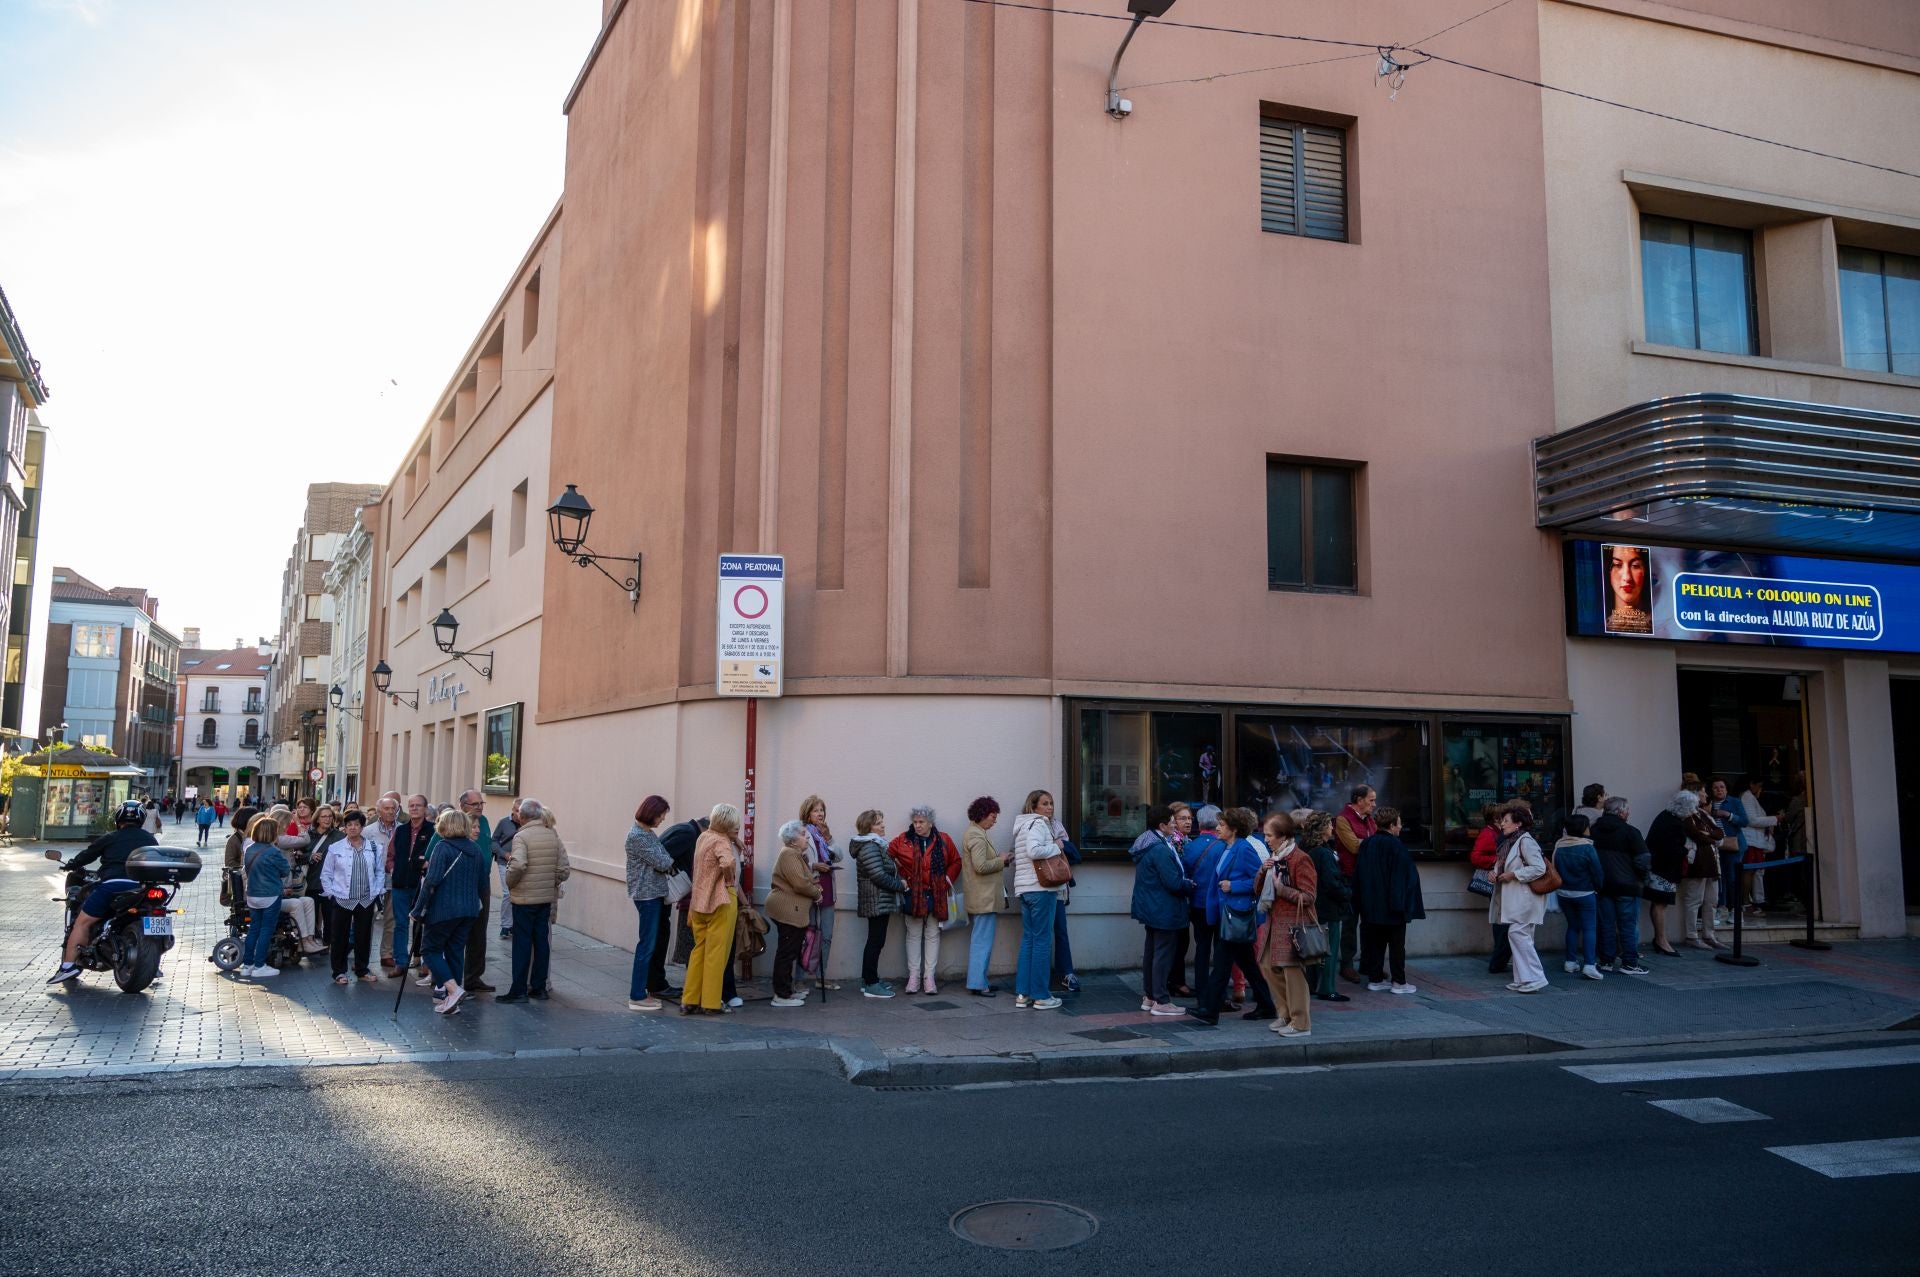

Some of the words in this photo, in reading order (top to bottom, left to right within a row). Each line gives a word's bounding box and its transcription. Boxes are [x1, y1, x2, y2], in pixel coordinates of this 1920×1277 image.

[745, 563, 781, 571] PEATONAL
[1682, 584, 1742, 599] PELICULA
[1746, 589, 1753, 598] +
[1756, 589, 1821, 604] COLOQUIO
[1824, 593, 1841, 605] ON
[1845, 595, 1872, 607] LINE
[1680, 611, 1701, 620] con
[1704, 610, 1715, 622] la
[1719, 611, 1769, 625] directora
[1772, 610, 1809, 627] ALAUDA
[1812, 612, 1834, 628] RUIZ
[1836, 614, 1849, 629] DE
[1852, 611, 1876, 631] AZÚA
